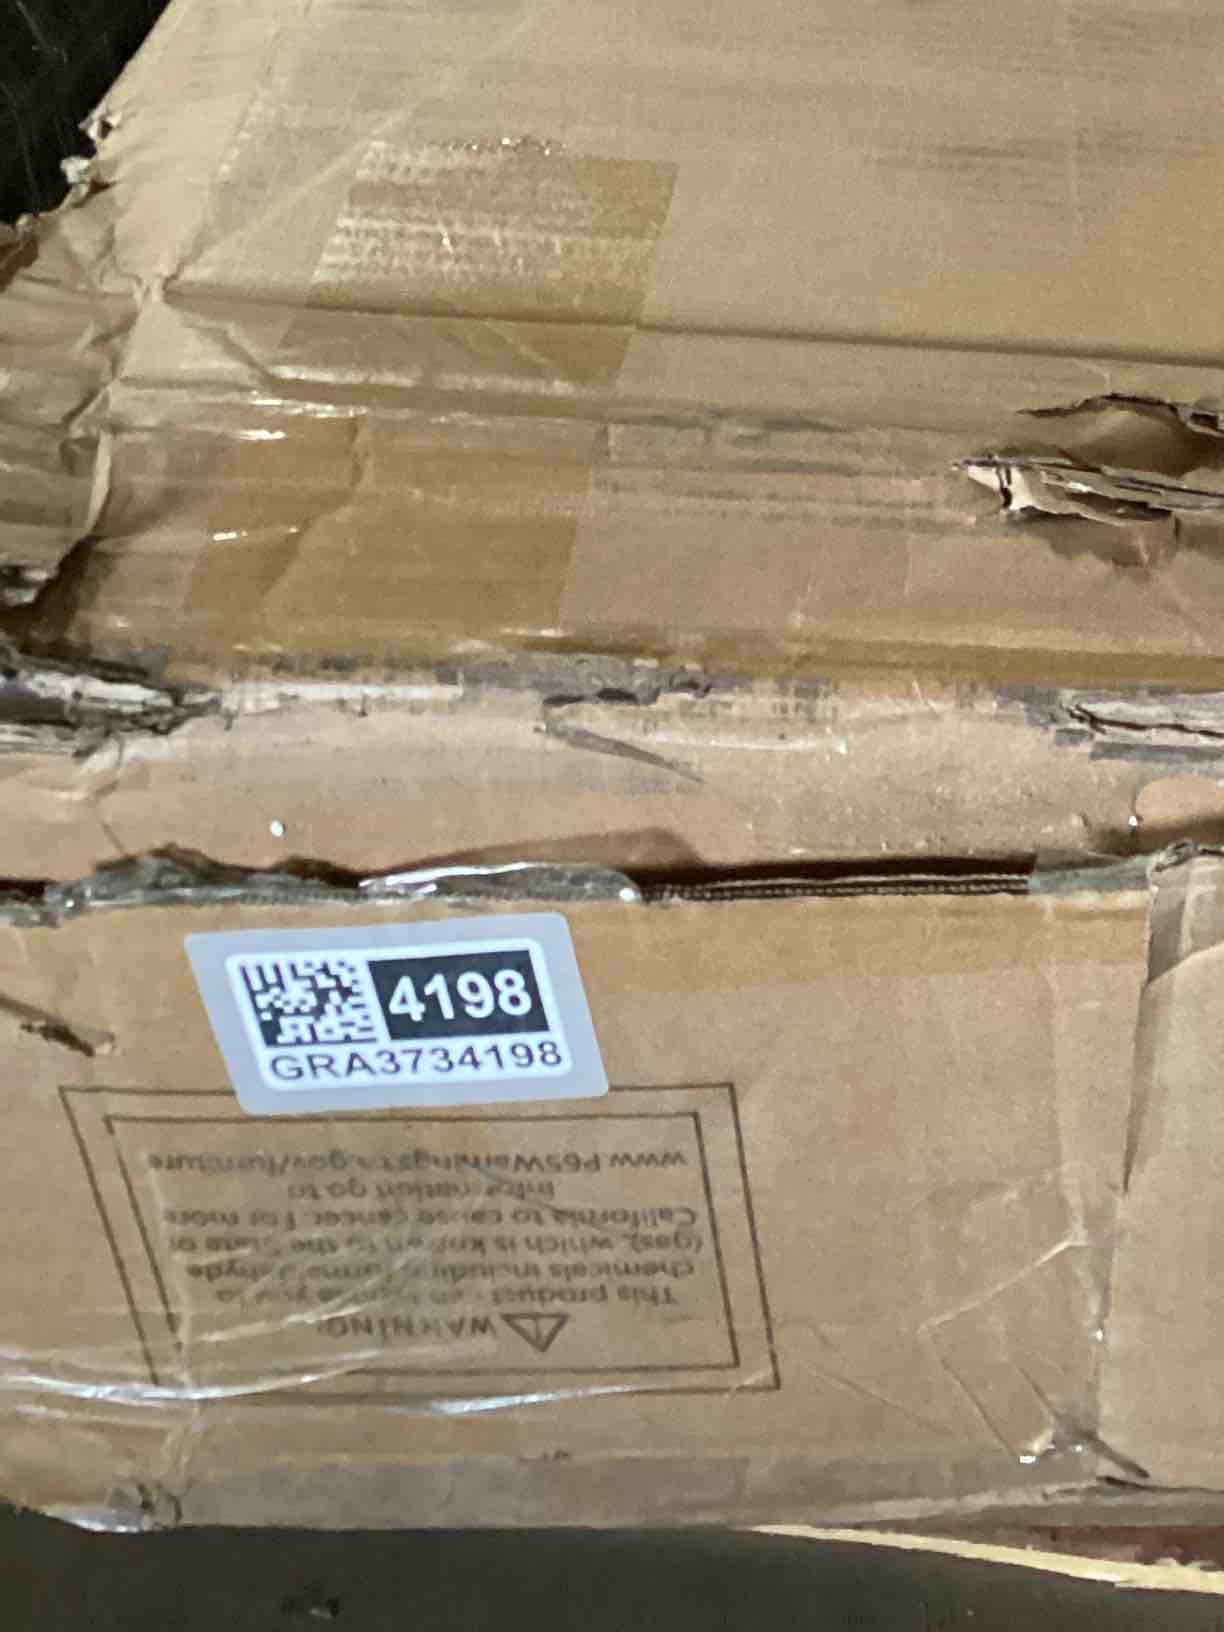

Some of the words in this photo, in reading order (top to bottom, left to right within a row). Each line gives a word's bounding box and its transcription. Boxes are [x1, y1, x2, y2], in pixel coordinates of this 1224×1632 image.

[388, 970, 532, 1023] 4198
[271, 1041, 563, 1081] GRA3734198
[326, 1176, 367, 1199] go
[511, 1208, 544, 1225] to
[551, 1206, 696, 1229] California
[499, 1234, 517, 1254] is
[524, 1234, 614, 1254] which
[549, 1262, 694, 1280] chemicals
[492, 1285, 608, 1306] product
[616, 1285, 679, 1305] This
